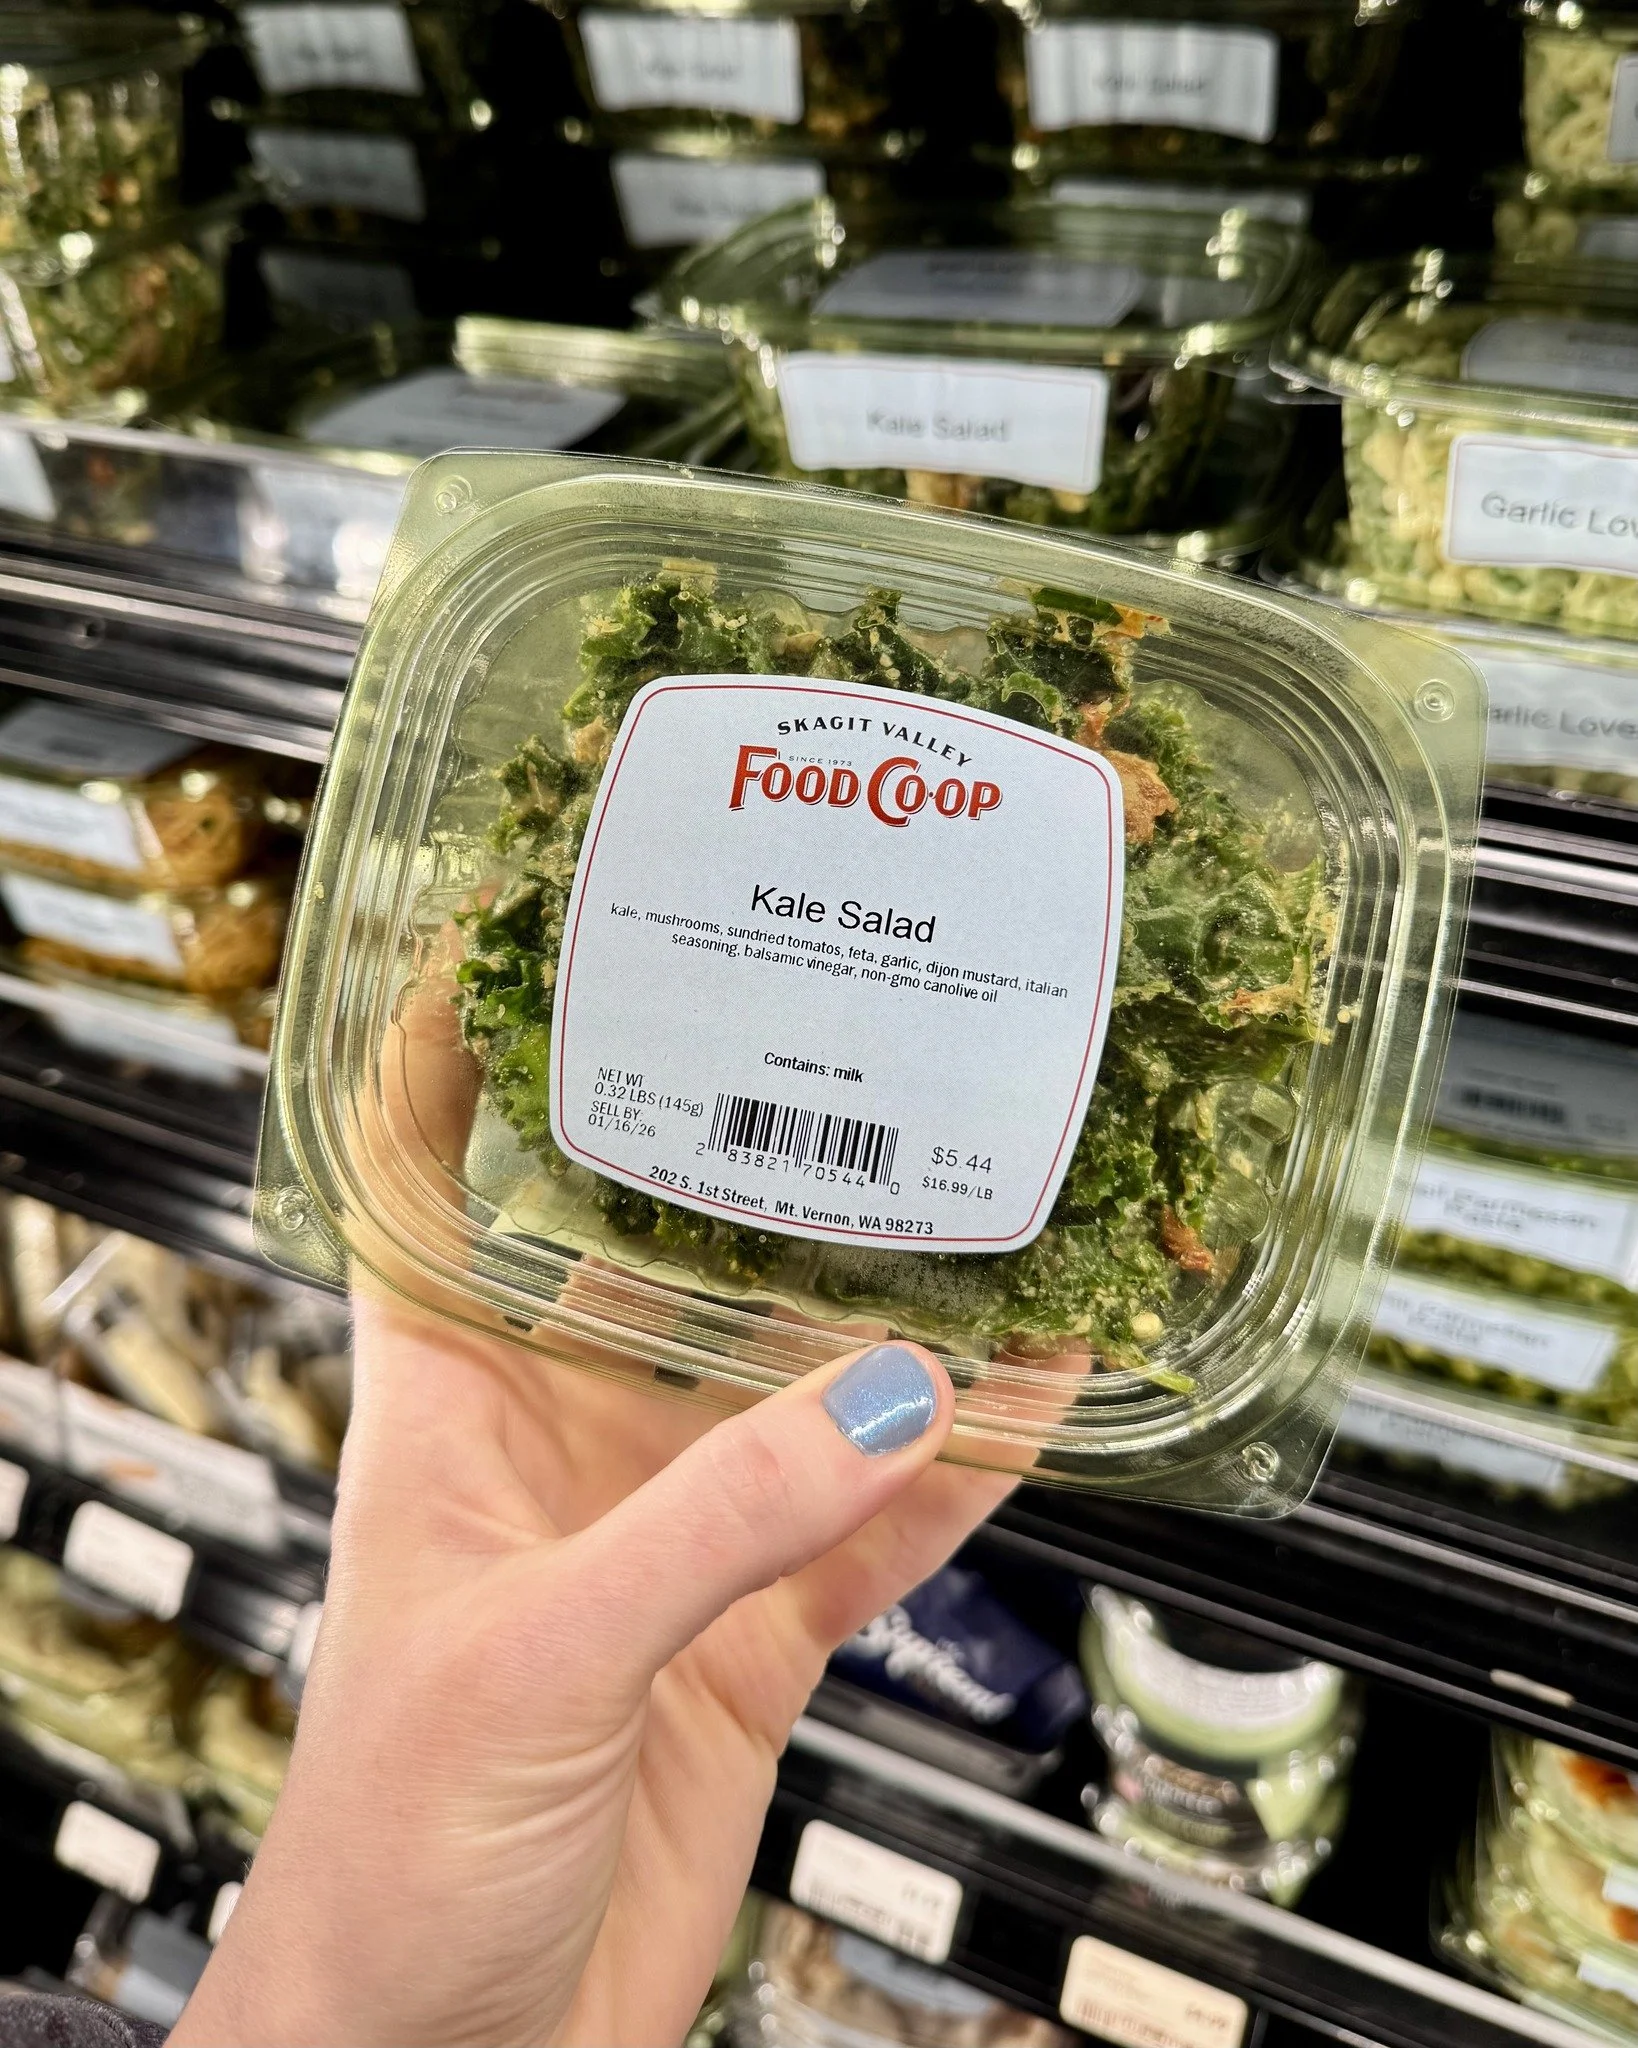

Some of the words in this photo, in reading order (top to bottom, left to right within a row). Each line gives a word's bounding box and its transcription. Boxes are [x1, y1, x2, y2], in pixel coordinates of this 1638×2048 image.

[1480, 490, 1577, 529] Garlic
[777, 716, 873, 736] SKAGIT
[882, 722, 972, 768] VALLEY
[788, 755, 823, 764] SINCE
[828, 759, 853, 767] 1973
[751, 884, 826, 924] Kale
[837, 900, 937, 943] Salad
[610, 902, 642, 921] kale,
[645, 909, 724, 937] mushrooms,
[727, 926, 786, 946] sundried
[787, 935, 845, 960] tomatos,
[880, 953, 922, 973] garlic,
[926, 960, 959, 979] dijon
[962, 968, 1022, 992] mustard,
[1025, 978, 1069, 999] italian
[671, 932, 741, 958] seasoning,
[744, 943, 804, 967] balsamic
[806, 956, 858, 980] vinegar,
[861, 967, 920, 988] non-gmo
[923, 979, 979, 1000] canolive
[981, 989, 999, 1003] oil
[597, 1066, 622, 1084] NET
[763, 1051, 831, 1077] Contains:
[833, 1066, 864, 1083] milk
[591, 1100, 619, 1118] SELL
[594, 1081, 627, 1100] 0.32
[629, 1088, 657, 1106] LBS
[658, 1094, 704, 1118] (145g)
[588, 1113, 656, 1138] 01/16/26
[727, 1148, 790, 1173] 83821
[802, 1162, 866, 1188] 70544
[931, 1146, 993, 1174] $5.44
[648, 1165, 678, 1186] 202
[679, 1175, 692, 1191] S.
[696, 1180, 720, 1199] 1st
[721, 1187, 768, 1212] Street,
[774, 1199, 798, 1218] Mt.
[802, 1205, 855, 1230] Vernon,
[858, 1214, 882, 1231] WA
[885, 1217, 934, 1235] 98273
[921, 1175, 994, 1201] $16.99/LB
